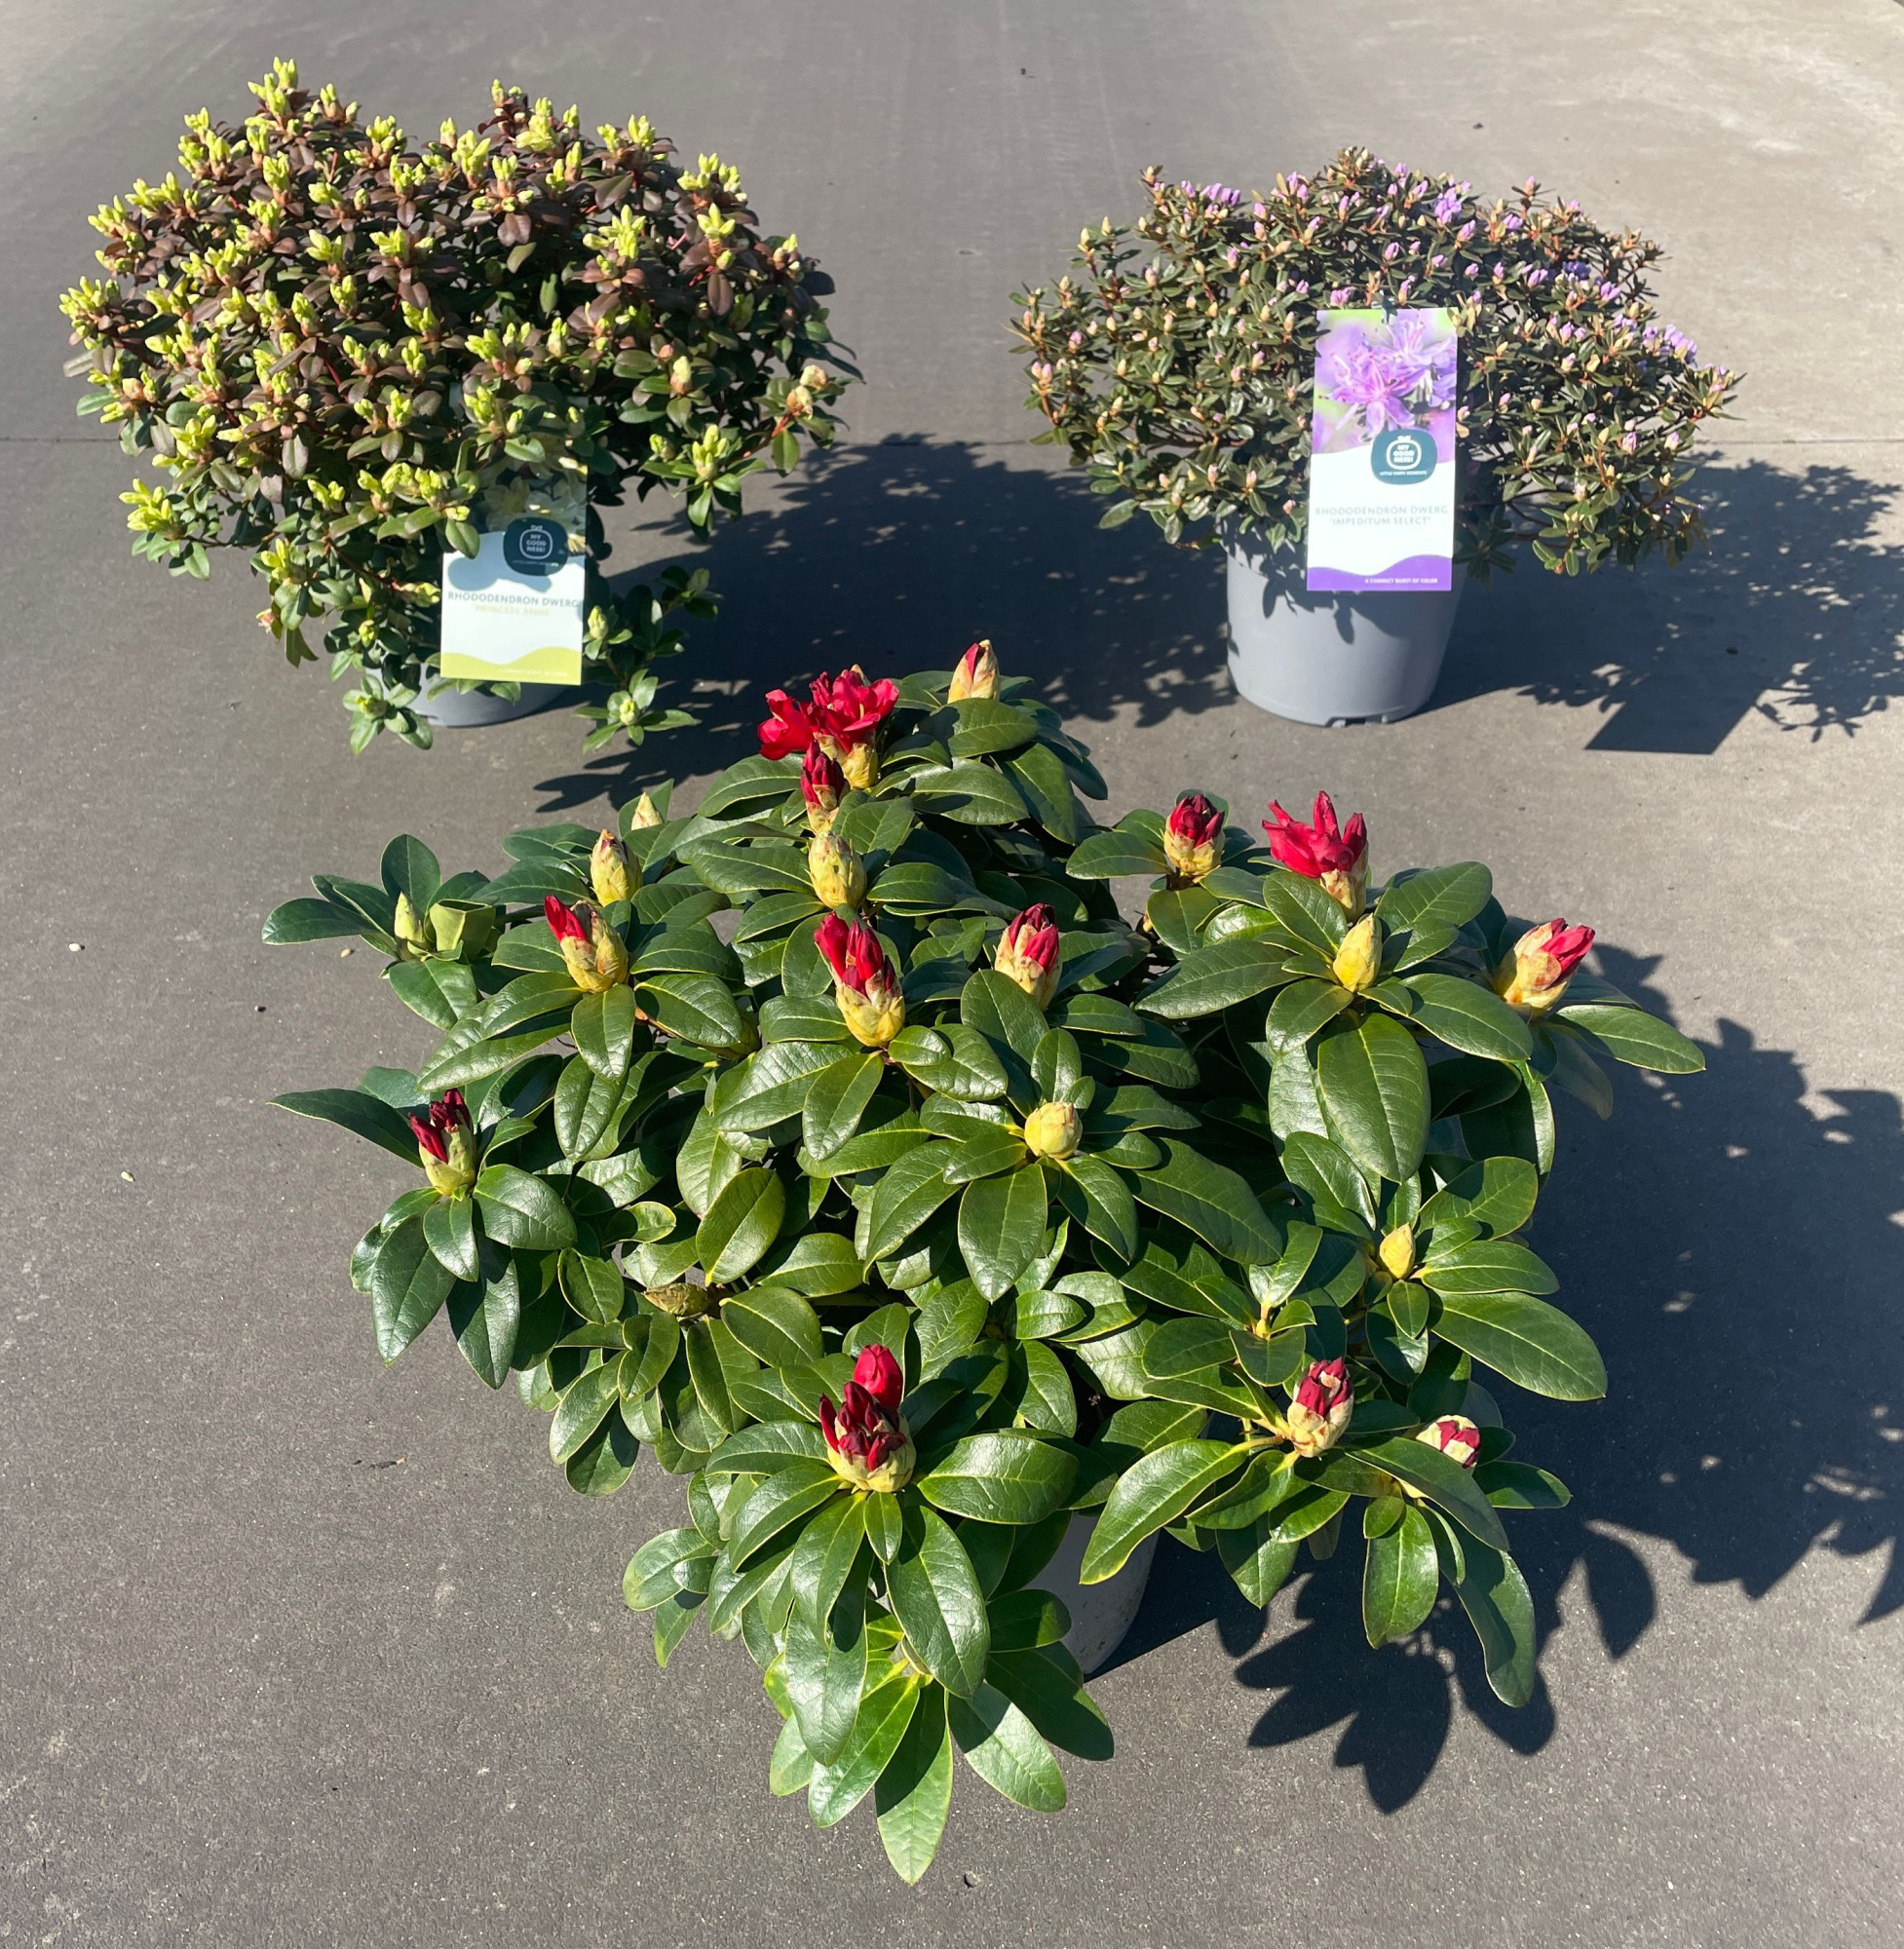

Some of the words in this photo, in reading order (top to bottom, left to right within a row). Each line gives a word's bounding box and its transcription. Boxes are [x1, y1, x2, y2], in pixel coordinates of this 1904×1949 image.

[1314, 506, 1407, 516] RHODODENDRON
[1410, 505, 1448, 515] DWERG
[447, 592, 539, 605] RHODODENDRON
